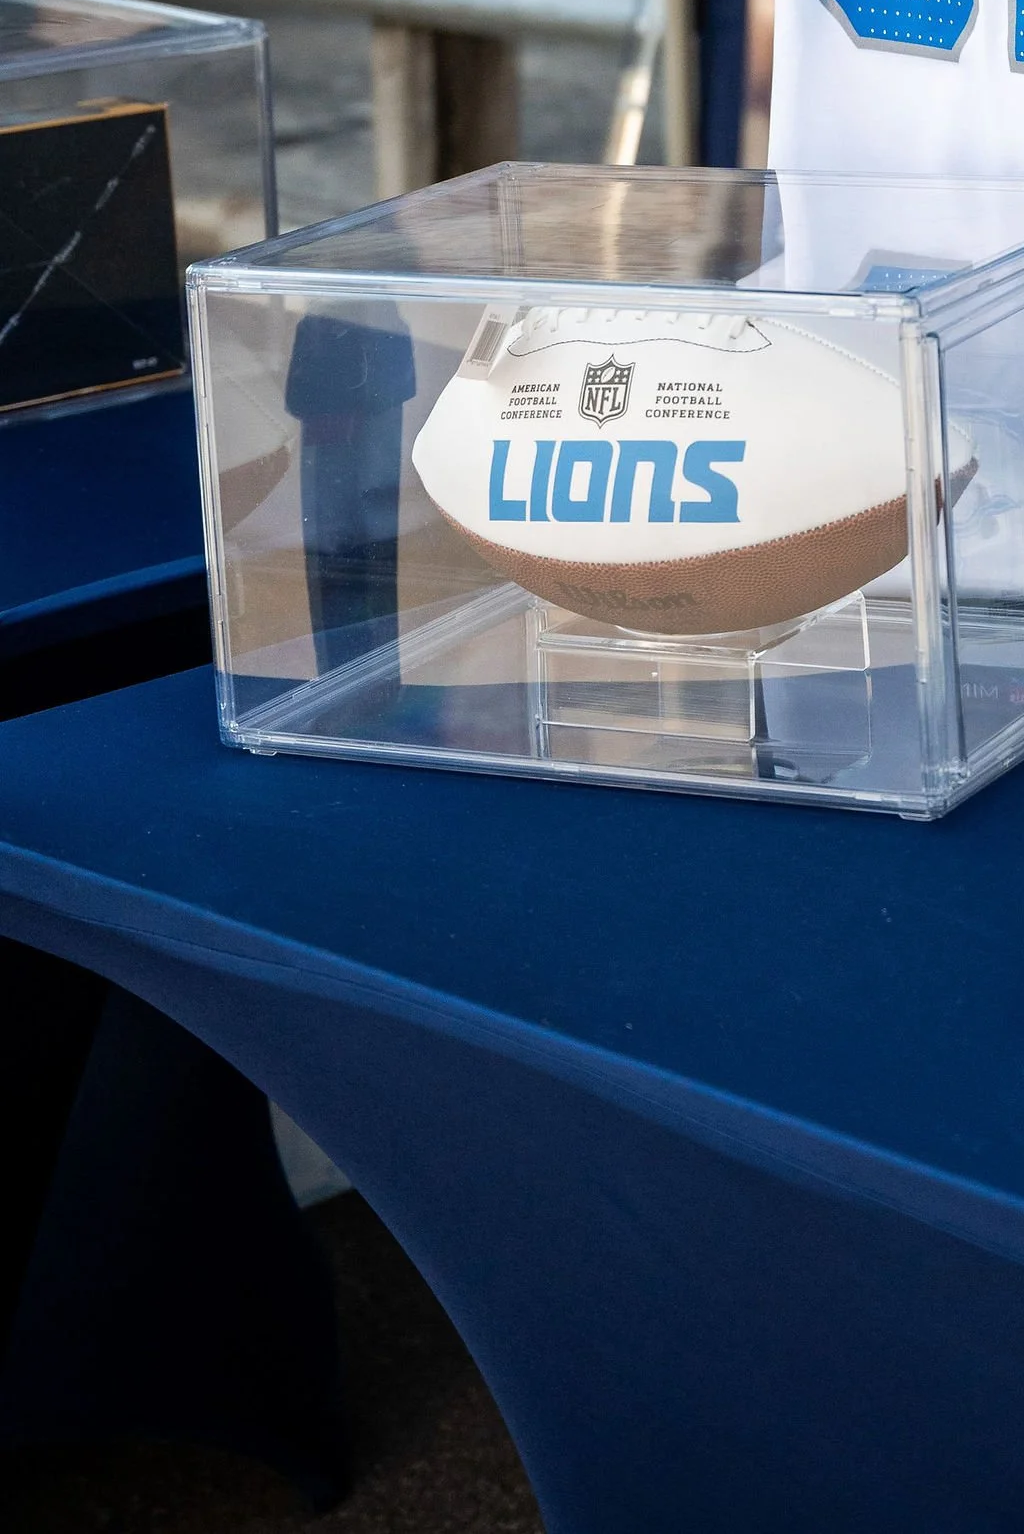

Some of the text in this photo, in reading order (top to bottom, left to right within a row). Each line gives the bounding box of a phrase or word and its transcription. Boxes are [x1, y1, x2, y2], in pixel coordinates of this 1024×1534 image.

[511, 383, 561, 394] AMERICAN
[657, 382, 723, 392] NATIONAL
[508, 396, 557, 407] FOOTBALL
[585, 386, 622, 415] NFL
[655, 395, 722, 406] FOOTBALL
[500, 409, 563, 420] CONFERENCE
[645, 409, 731, 420] CONFERENCE
[489, 439, 747, 523] LIONS
